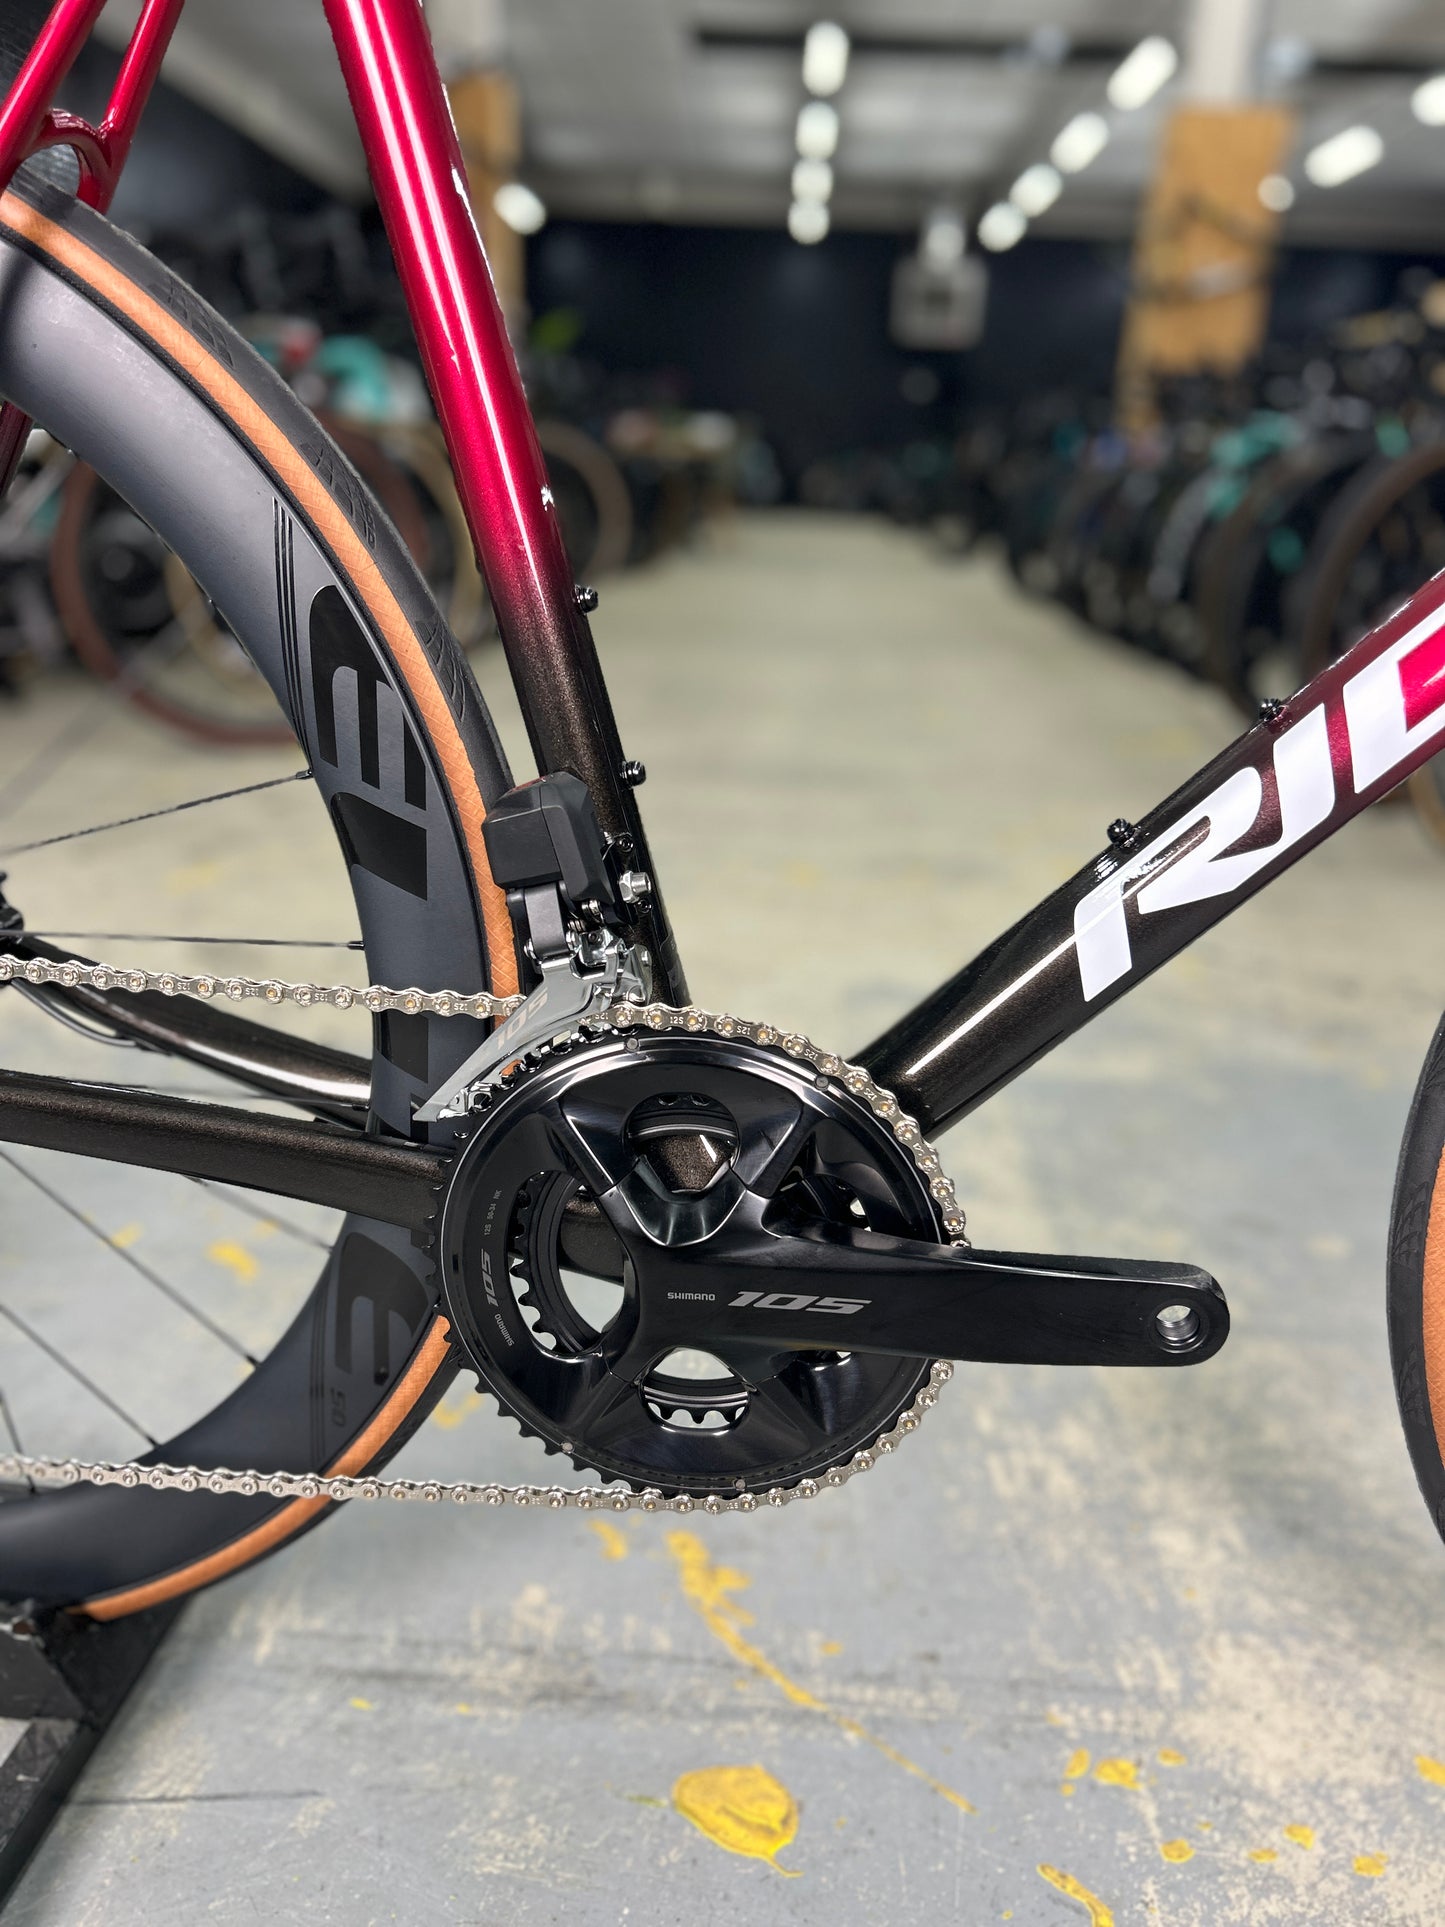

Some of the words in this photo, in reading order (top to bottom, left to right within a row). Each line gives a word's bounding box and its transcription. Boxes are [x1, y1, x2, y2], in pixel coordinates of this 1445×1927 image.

[453, 1002, 468, 1011] 12S
[497, 987, 548, 1050] 105
[669, 1016, 684, 1025] 12S
[736, 1026, 751, 1036] 12S
[803, 1048, 819, 1061] 12S
[863, 1087, 877, 1101] 12S
[484, 1224, 492, 1236] 12S
[481, 1248, 499, 1307] 105
[667, 1292, 716, 1301] SHIMANO
[728, 1291, 872, 1315] 105
[494, 1313, 515, 1347] SHIMANO
